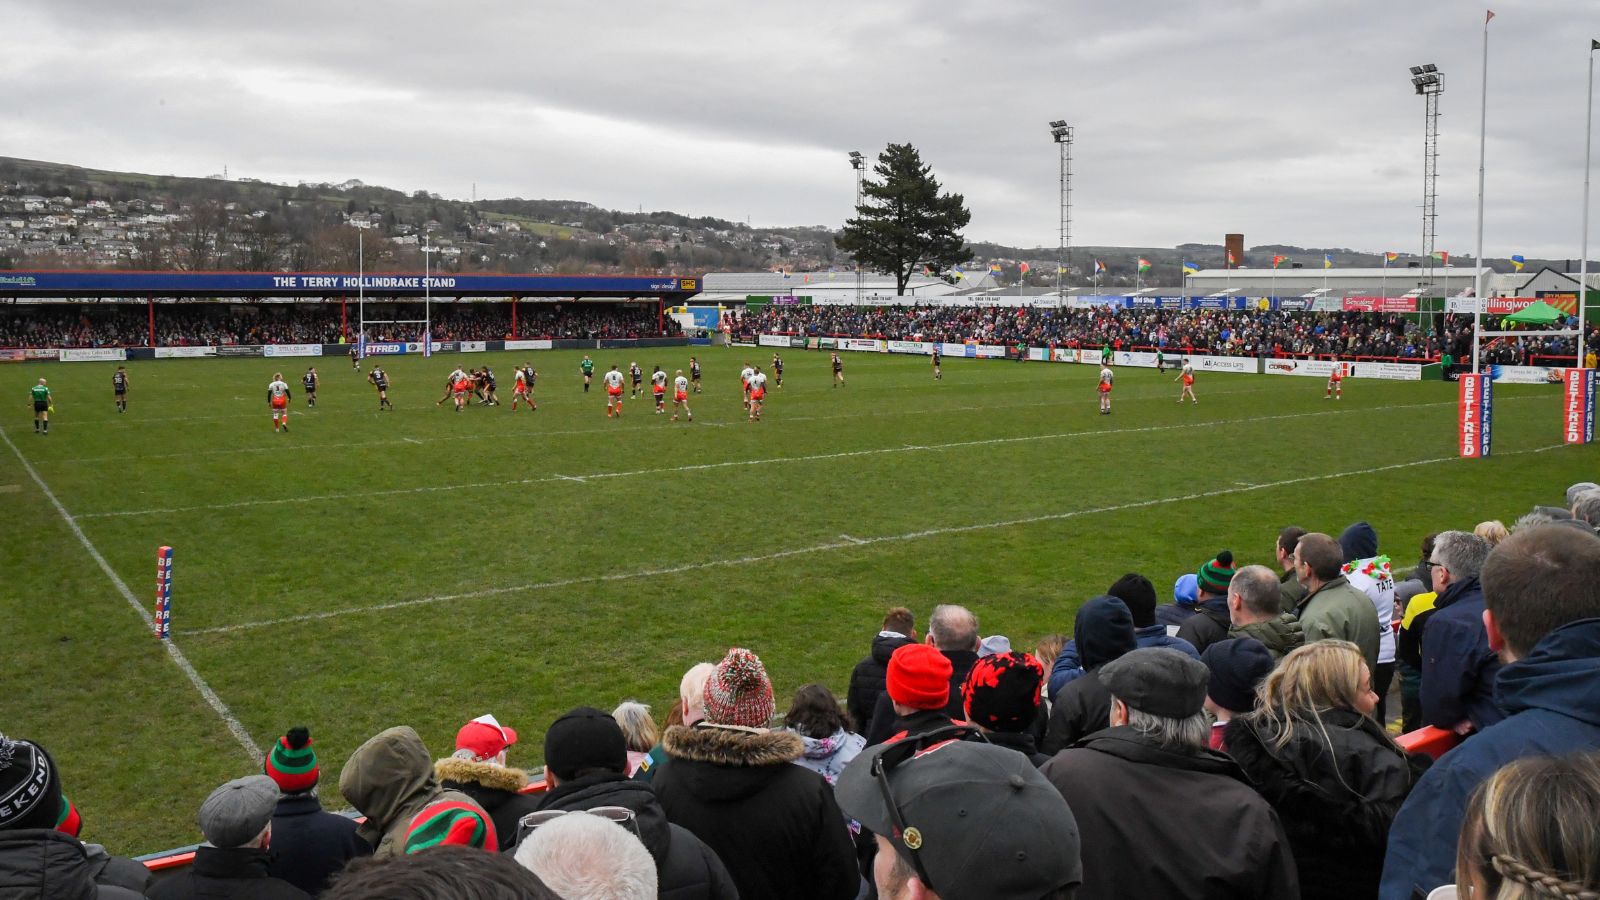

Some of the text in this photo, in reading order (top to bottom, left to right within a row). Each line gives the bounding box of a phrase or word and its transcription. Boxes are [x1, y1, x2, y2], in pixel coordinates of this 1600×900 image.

[273, 277, 456, 288] THE TERRY HOLLINDRAKE STAND
[1487, 299, 1546, 310] illingwor
[365, 345, 400, 353] ETFRED
[1463, 377, 1474, 456] BETFRED
[1482, 377, 1490, 456] BETFRED
[1568, 371, 1579, 442] BETFRED
[1586, 371, 1594, 442] BETFRED
[1376, 579, 1393, 593] TATE
